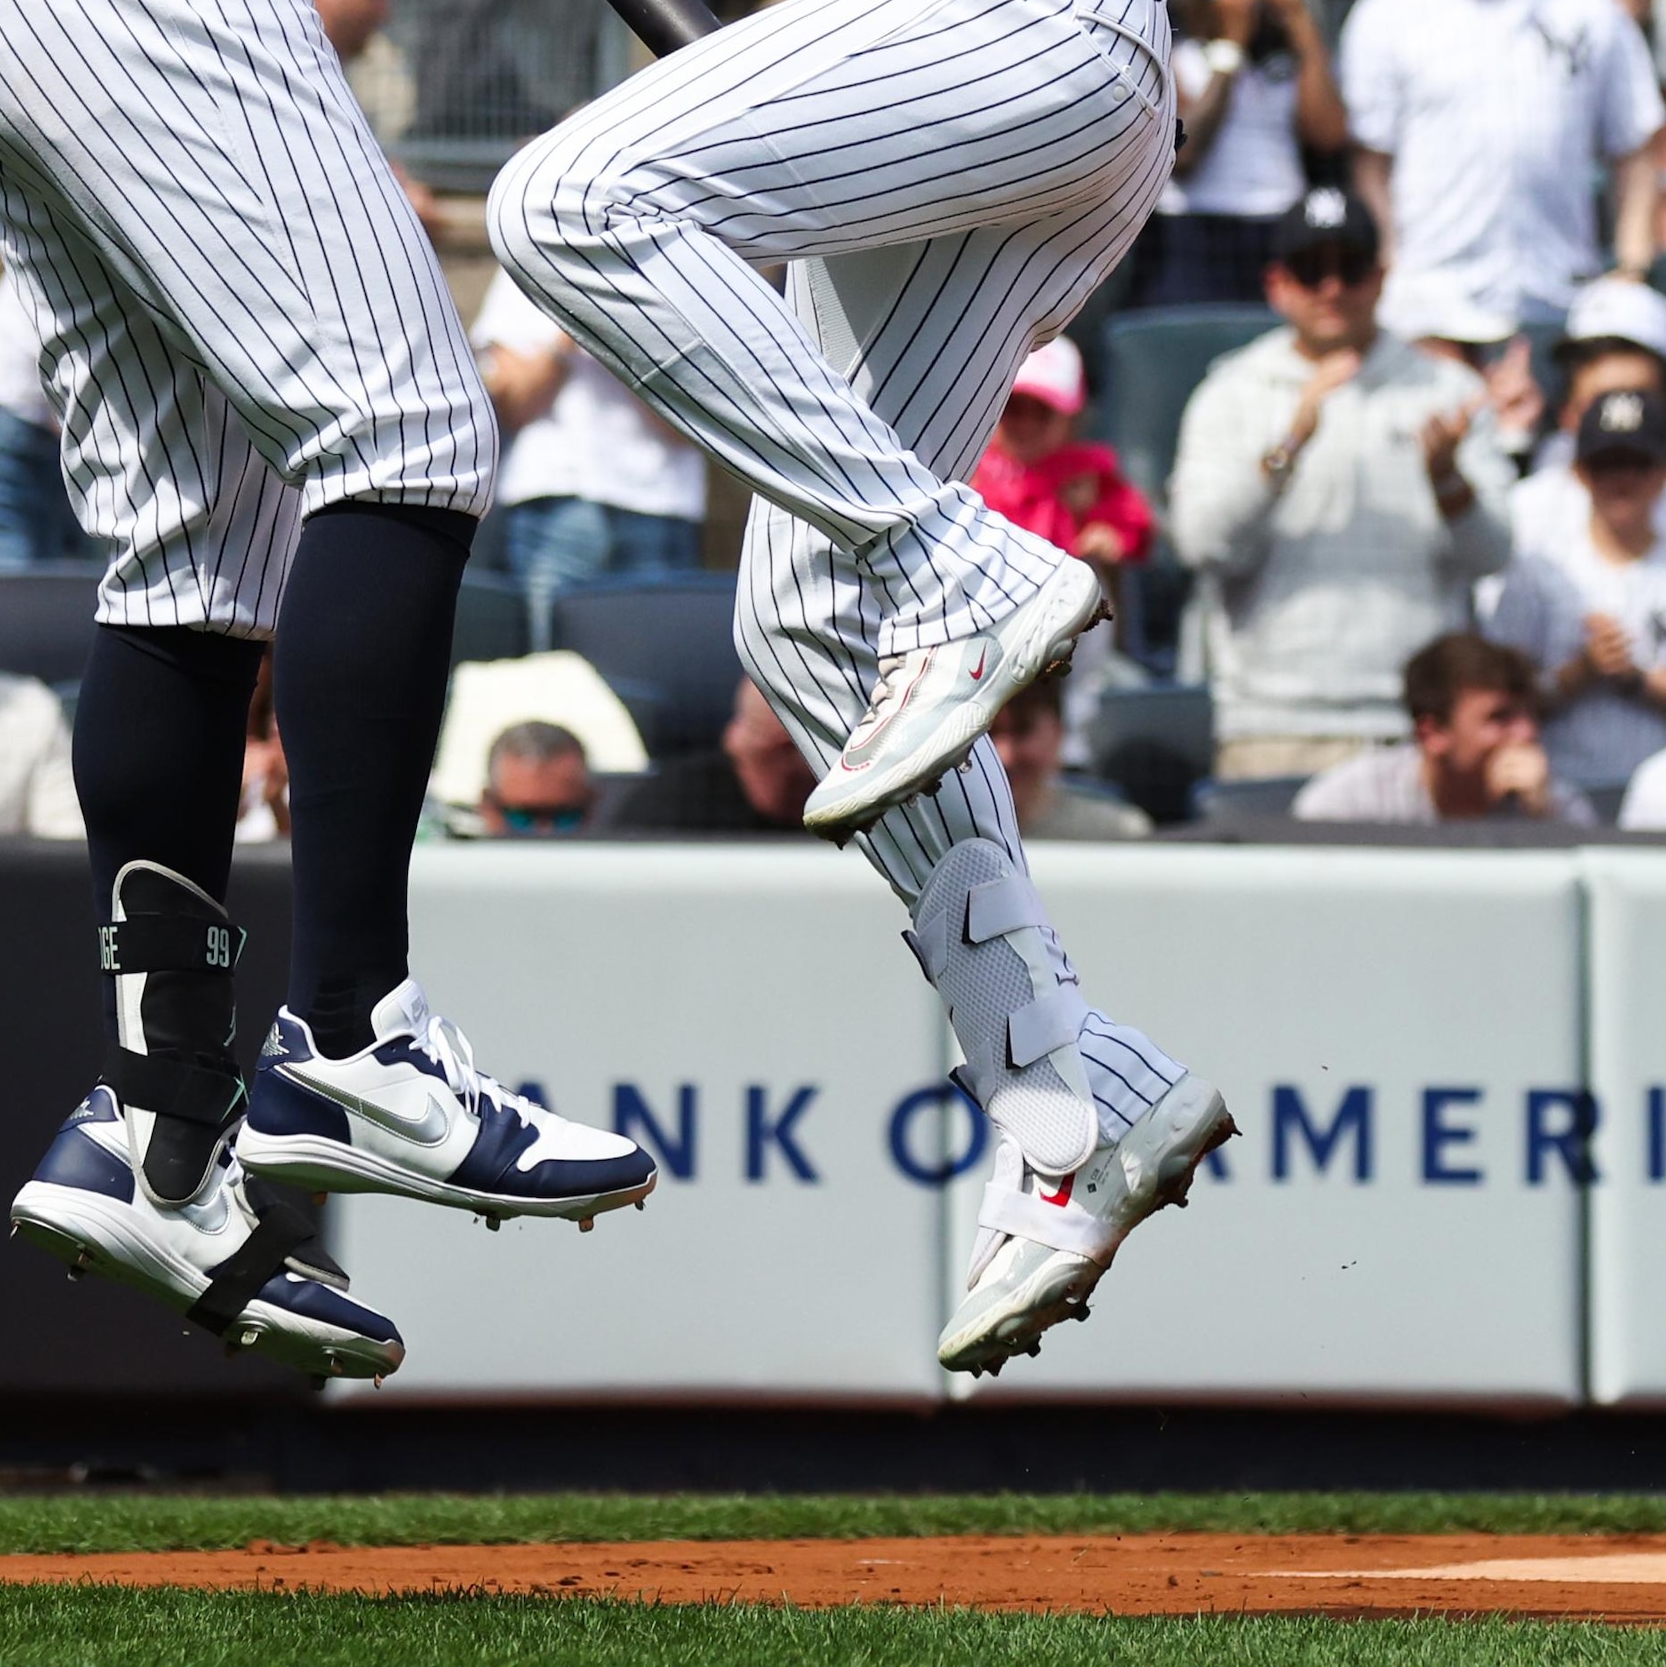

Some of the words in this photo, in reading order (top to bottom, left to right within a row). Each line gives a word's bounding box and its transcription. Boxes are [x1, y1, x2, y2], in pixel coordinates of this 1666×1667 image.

[98, 925, 121, 970] GE
[206, 925, 231, 969] 99
[886, 1081, 989, 1189] O
